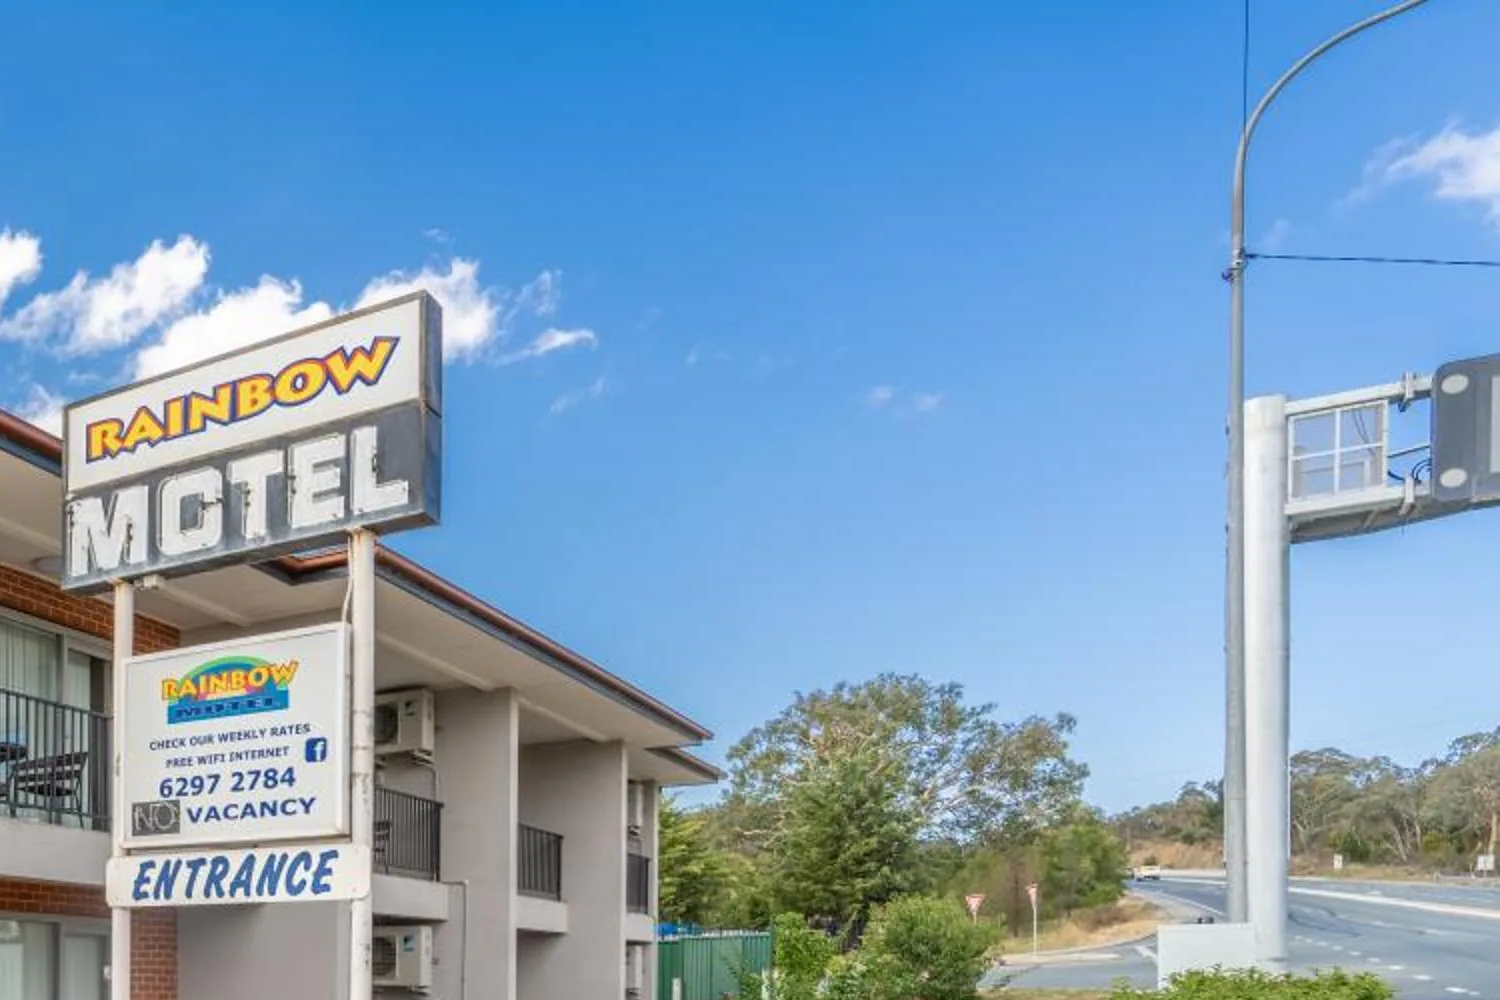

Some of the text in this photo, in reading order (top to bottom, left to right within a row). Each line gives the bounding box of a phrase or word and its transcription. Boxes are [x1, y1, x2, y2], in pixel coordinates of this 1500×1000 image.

[86, 336, 400, 463] RAINBOW
[65, 425, 409, 578] MOTEL
[162, 658, 299, 701] RAINBOW
[149, 723, 311, 751] CHECK OUR WEEKLY RATES
[166, 746, 290, 768] FREE WIFI INTERNET
[159, 766, 296, 798] 6297 2784
[134, 797, 317, 832] NO VACANCY
[131, 849, 339, 901] ENTRANCE
